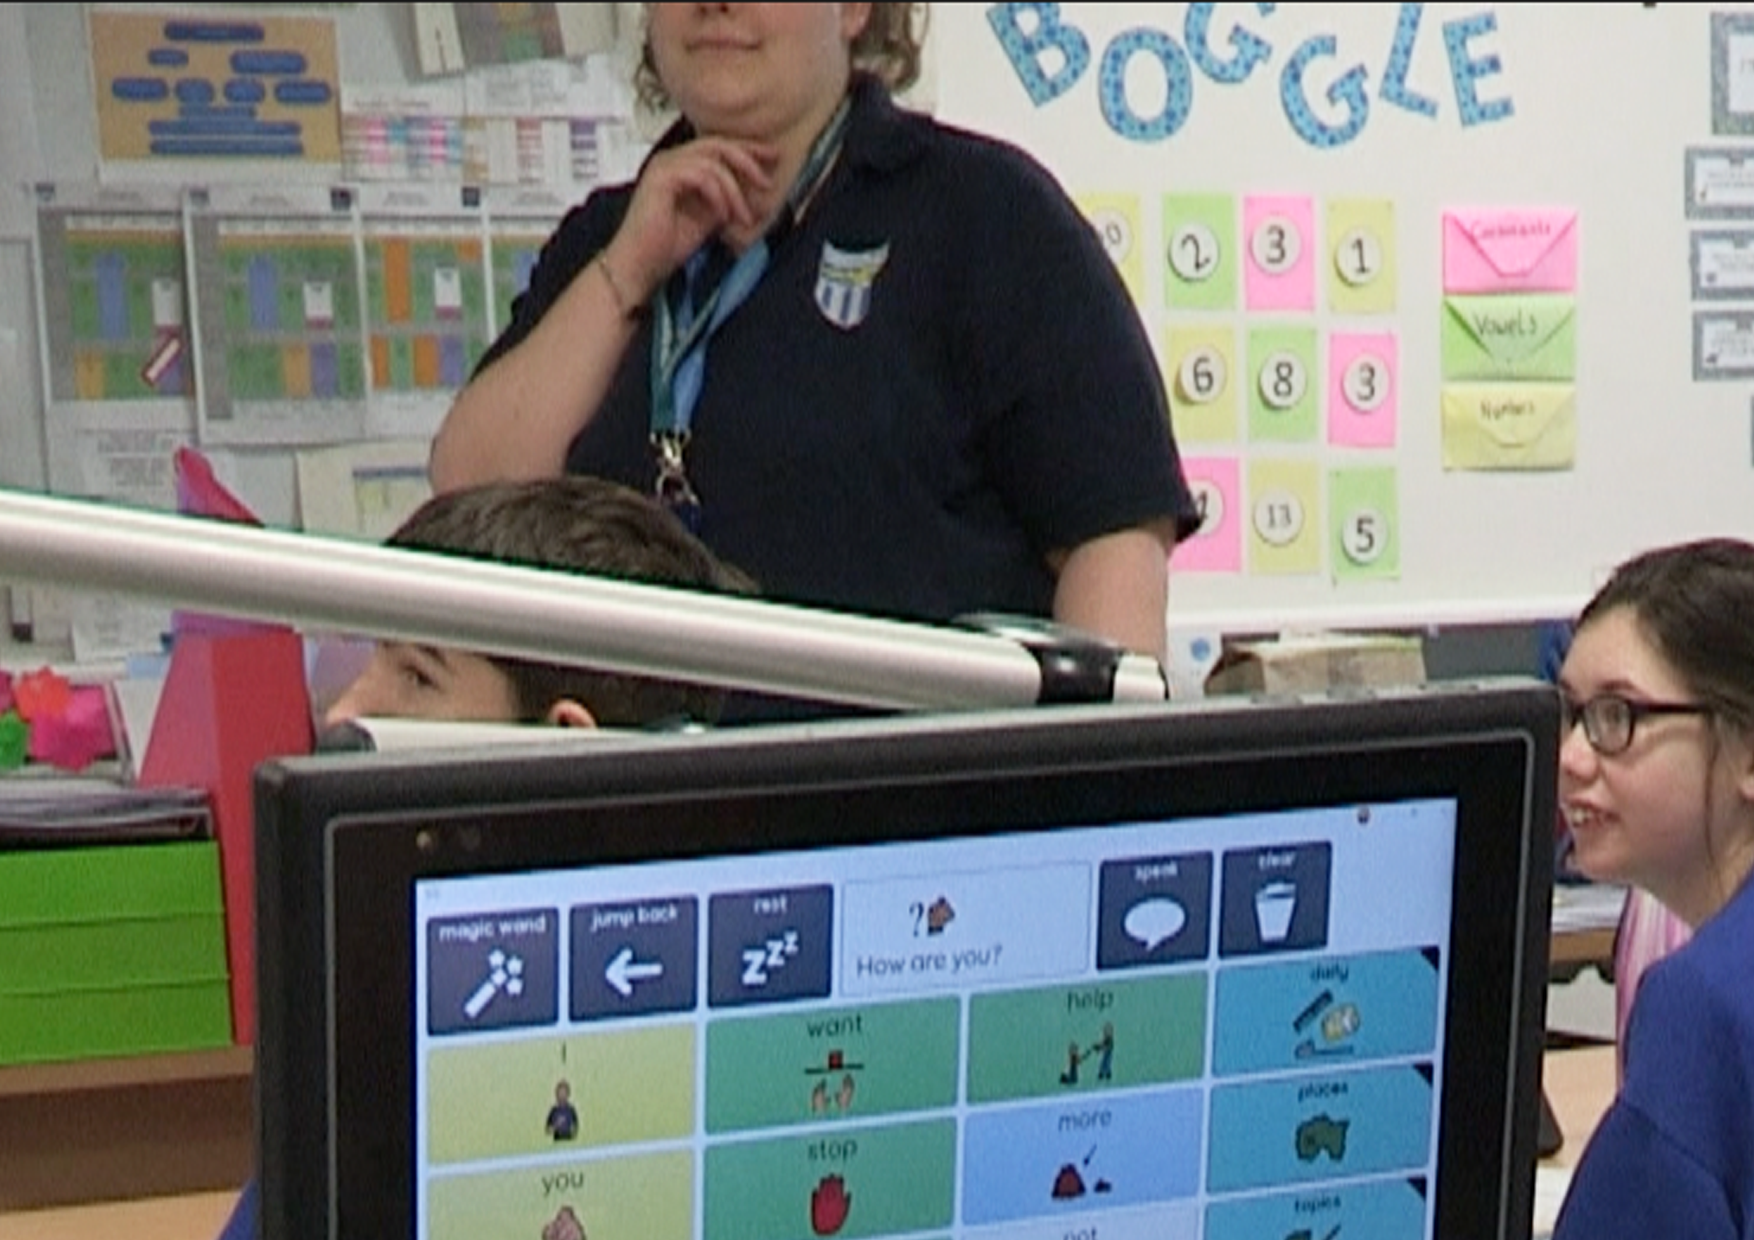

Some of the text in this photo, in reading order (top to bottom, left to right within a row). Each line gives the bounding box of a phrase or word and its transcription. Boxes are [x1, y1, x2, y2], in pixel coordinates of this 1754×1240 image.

[986, 2, 1515, 149] BOGGLE
[1180, 233, 1211, 273] 2
[1265, 224, 1287, 265] 3
[1350, 237, 1371, 275] 1
[1473, 307, 1538, 337] Vowels
[1192, 356, 1215, 394] 6
[1272, 361, 1294, 398] 8
[1355, 362, 1377, 402] 3
[1355, 517, 1376, 553] 5
[590, 903, 678, 933] jump back
[753, 895, 788, 914] rest
[438, 915, 547, 943] magic wand
[856, 943, 1004, 977] How are you?
[1309, 963, 1350, 983] daily
[1066, 988, 1114, 1014] help
[806, 1013, 864, 1039] want
[1298, 1080, 1350, 1104] places
[1057, 1109, 1113, 1133] more
[806, 1136, 859, 1164] stop
[541, 1171, 585, 1194] you
[1293, 1192, 1342, 1217] topics
